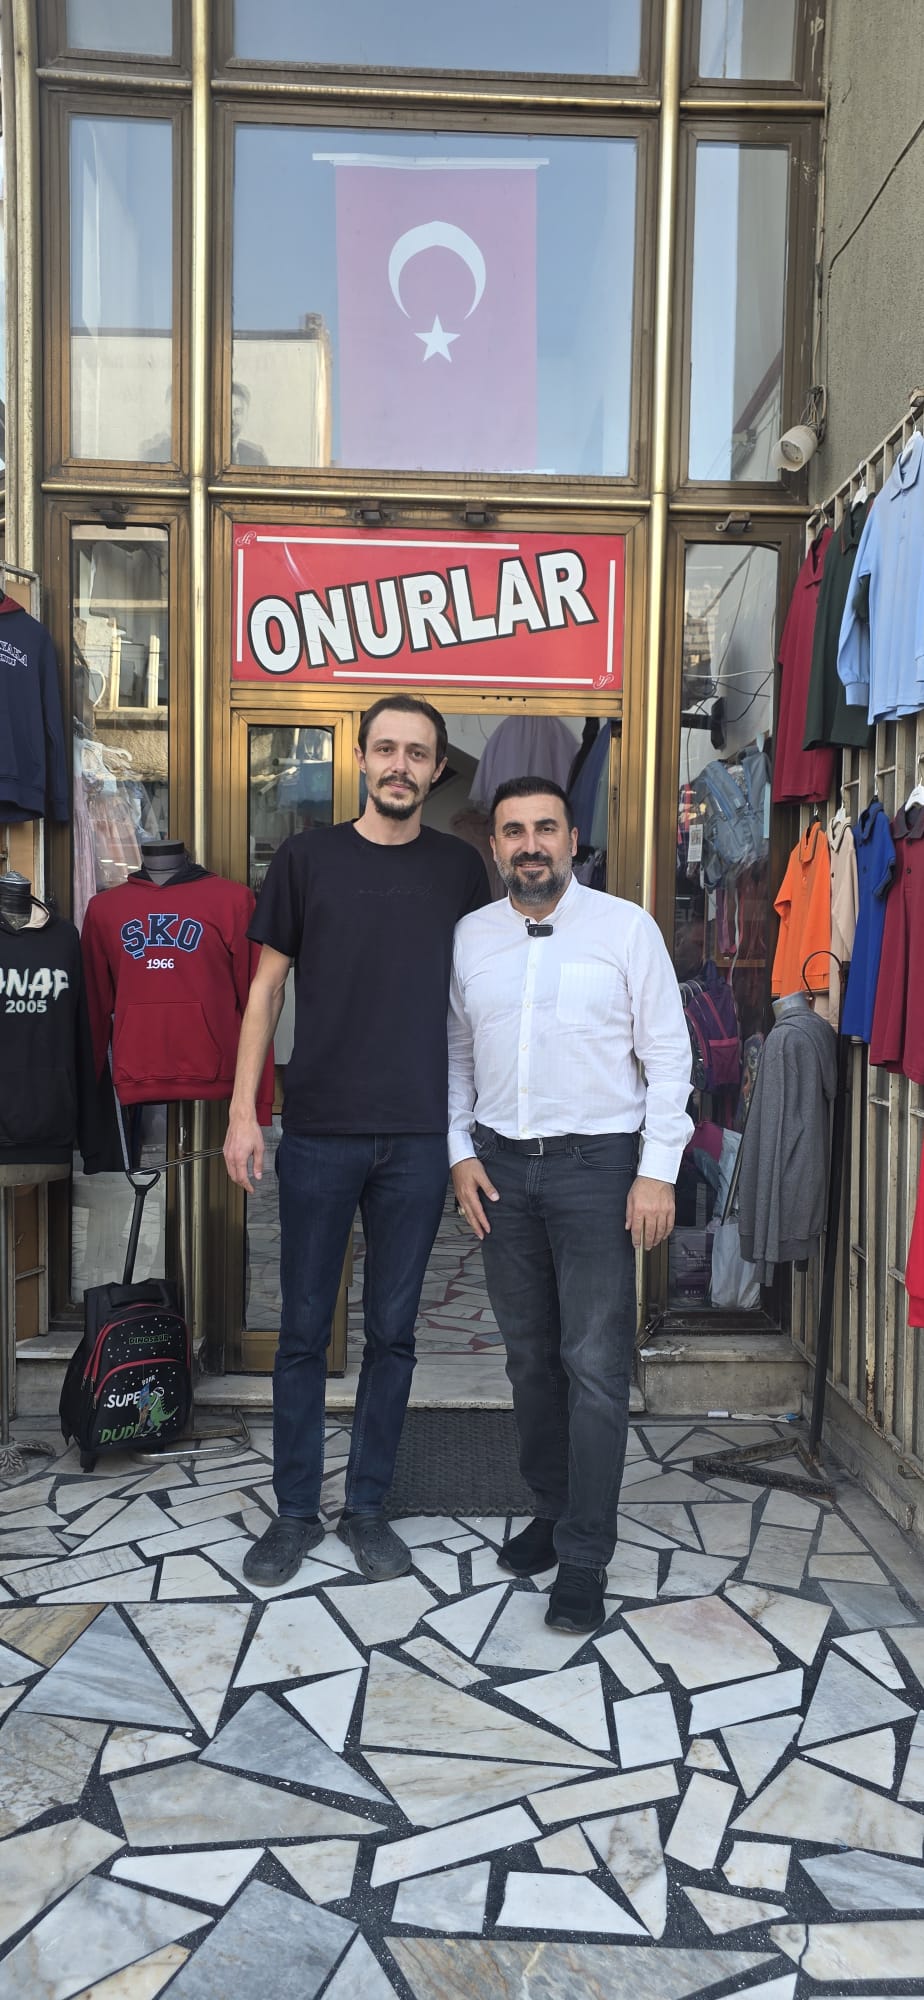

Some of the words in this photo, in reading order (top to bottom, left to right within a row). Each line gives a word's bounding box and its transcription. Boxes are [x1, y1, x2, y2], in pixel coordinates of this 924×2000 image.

[247, 548, 599, 675] ONURLAR
[0, 640, 28, 667] YAKA
[121, 914, 203, 959] ŞKO
[146, 958, 175, 969] 1966
[5, 999, 48, 1013] 2005
[107, 1391, 141, 1408] SUPE
